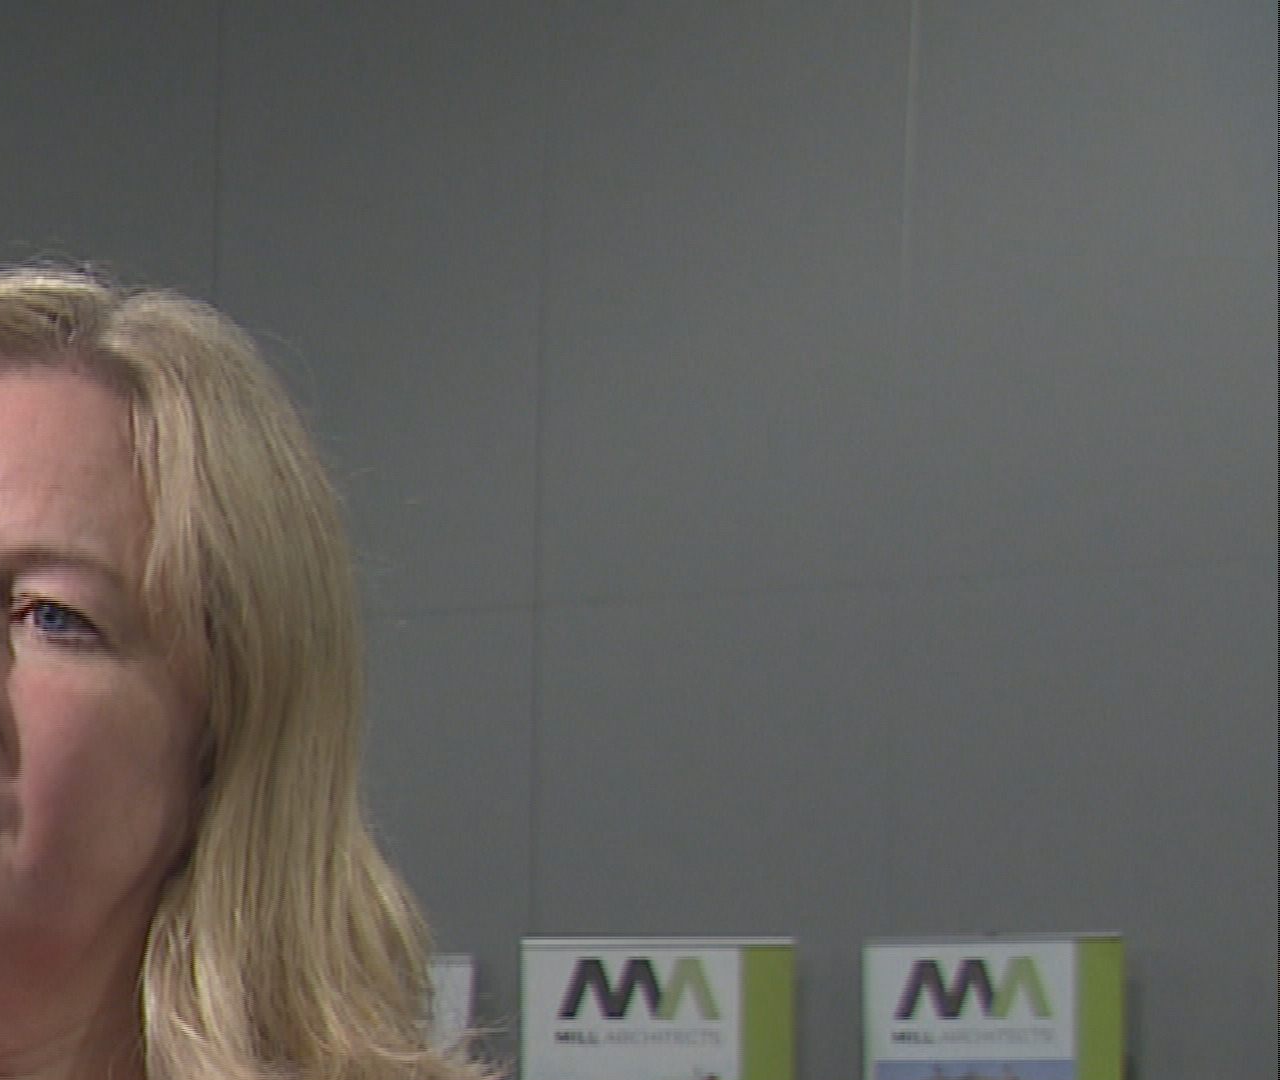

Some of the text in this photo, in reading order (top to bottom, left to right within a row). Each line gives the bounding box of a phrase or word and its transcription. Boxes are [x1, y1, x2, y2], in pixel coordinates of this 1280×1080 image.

[555, 1029, 721, 1045] MILL ARCHITECTS
[891, 1028, 1054, 1044] MILL ARCHITECTS
